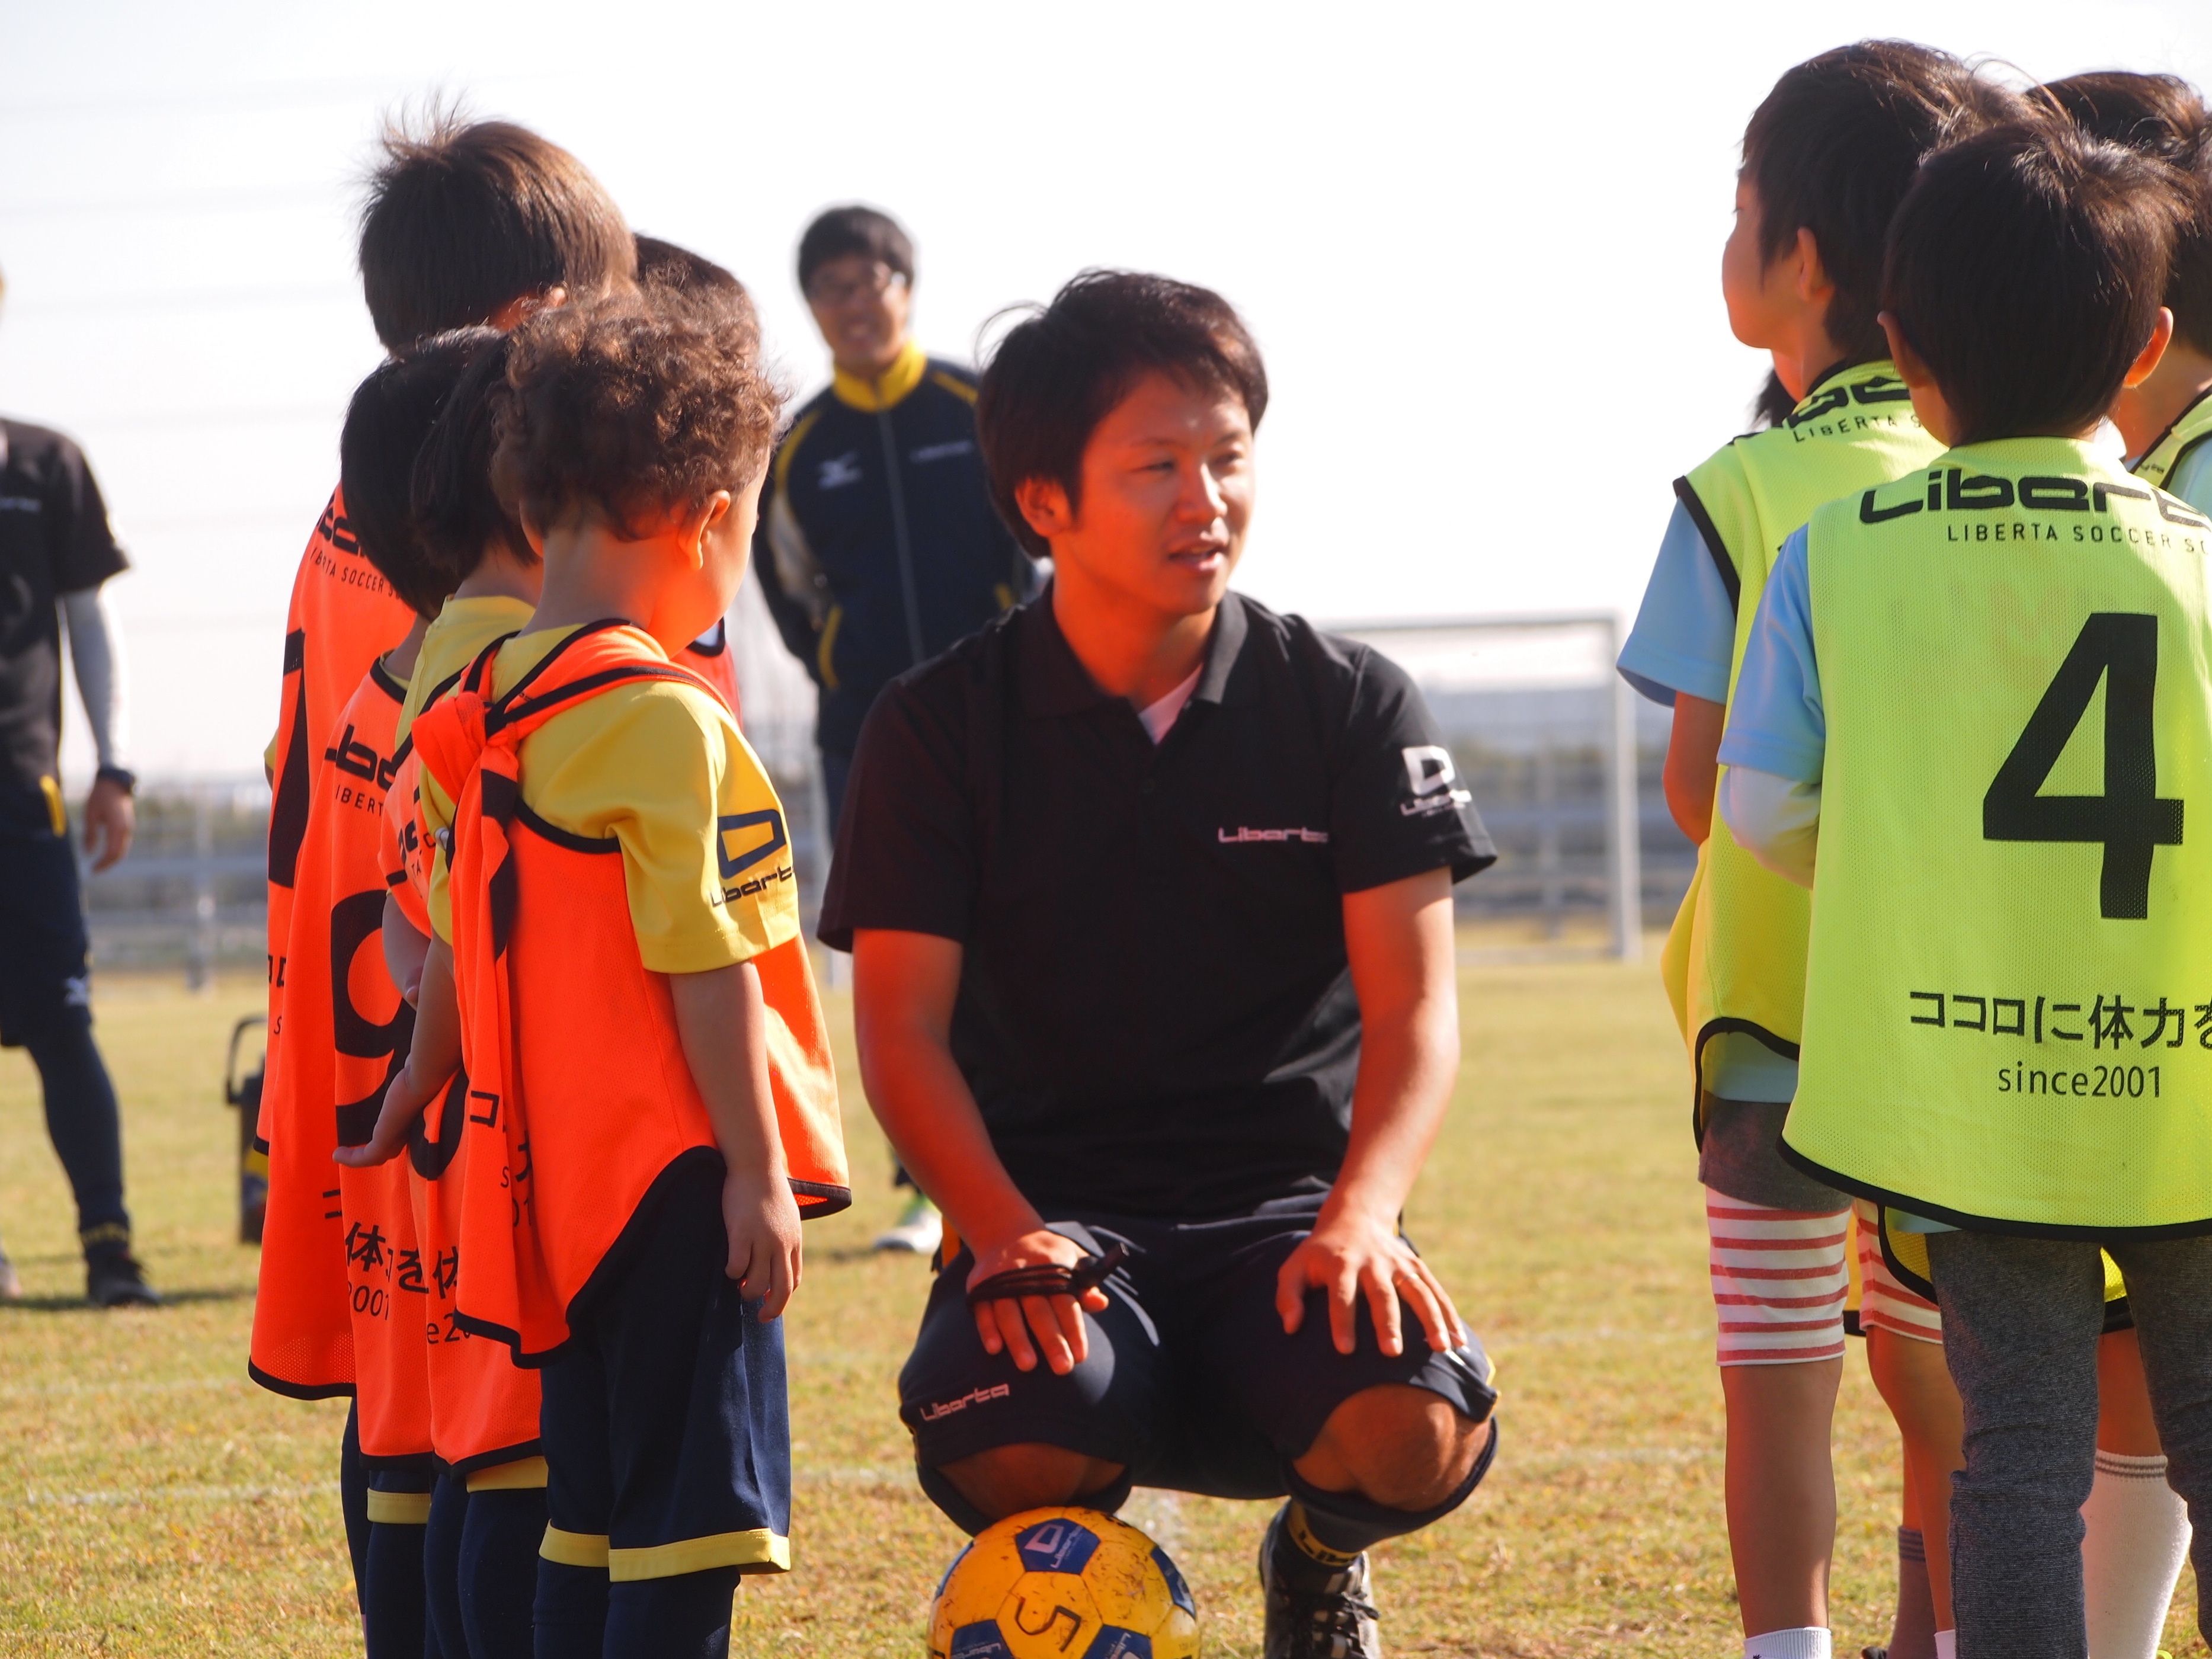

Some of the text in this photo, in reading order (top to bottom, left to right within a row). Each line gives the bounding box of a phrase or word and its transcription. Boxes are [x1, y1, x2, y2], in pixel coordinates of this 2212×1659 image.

[1792, 415, 1897, 443] LIBERTA
[1947, 523, 2058, 542] LIBERTA
[2073, 525, 2172, 549] SOCCER
[341, 565, 385, 593] SOCCER
[1983, 612, 2184, 920] 4
[1998, 1060, 2160, 1098] since2001
